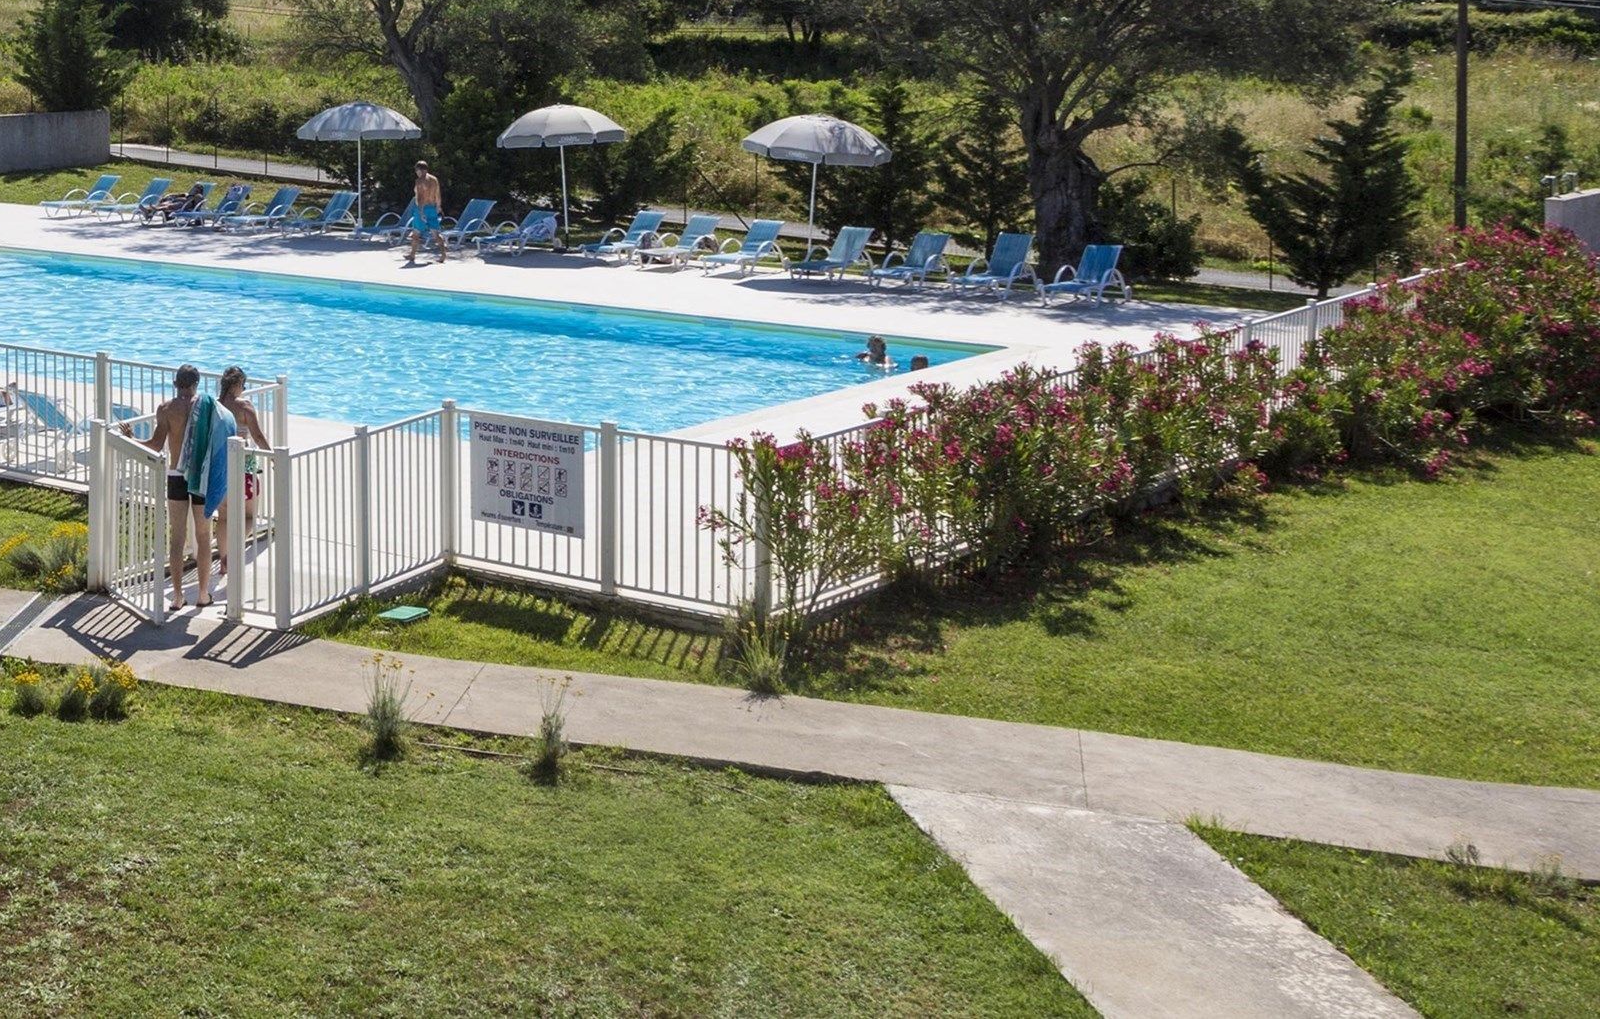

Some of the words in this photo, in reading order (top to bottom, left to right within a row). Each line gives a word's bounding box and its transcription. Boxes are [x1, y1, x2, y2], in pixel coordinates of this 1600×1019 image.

[474, 421, 506, 434] PISCINE
[509, 426, 527, 437] NON
[493, 448, 561, 465] INTERDICTIONS
[499, 489, 554, 505] OBLIGATIONS
